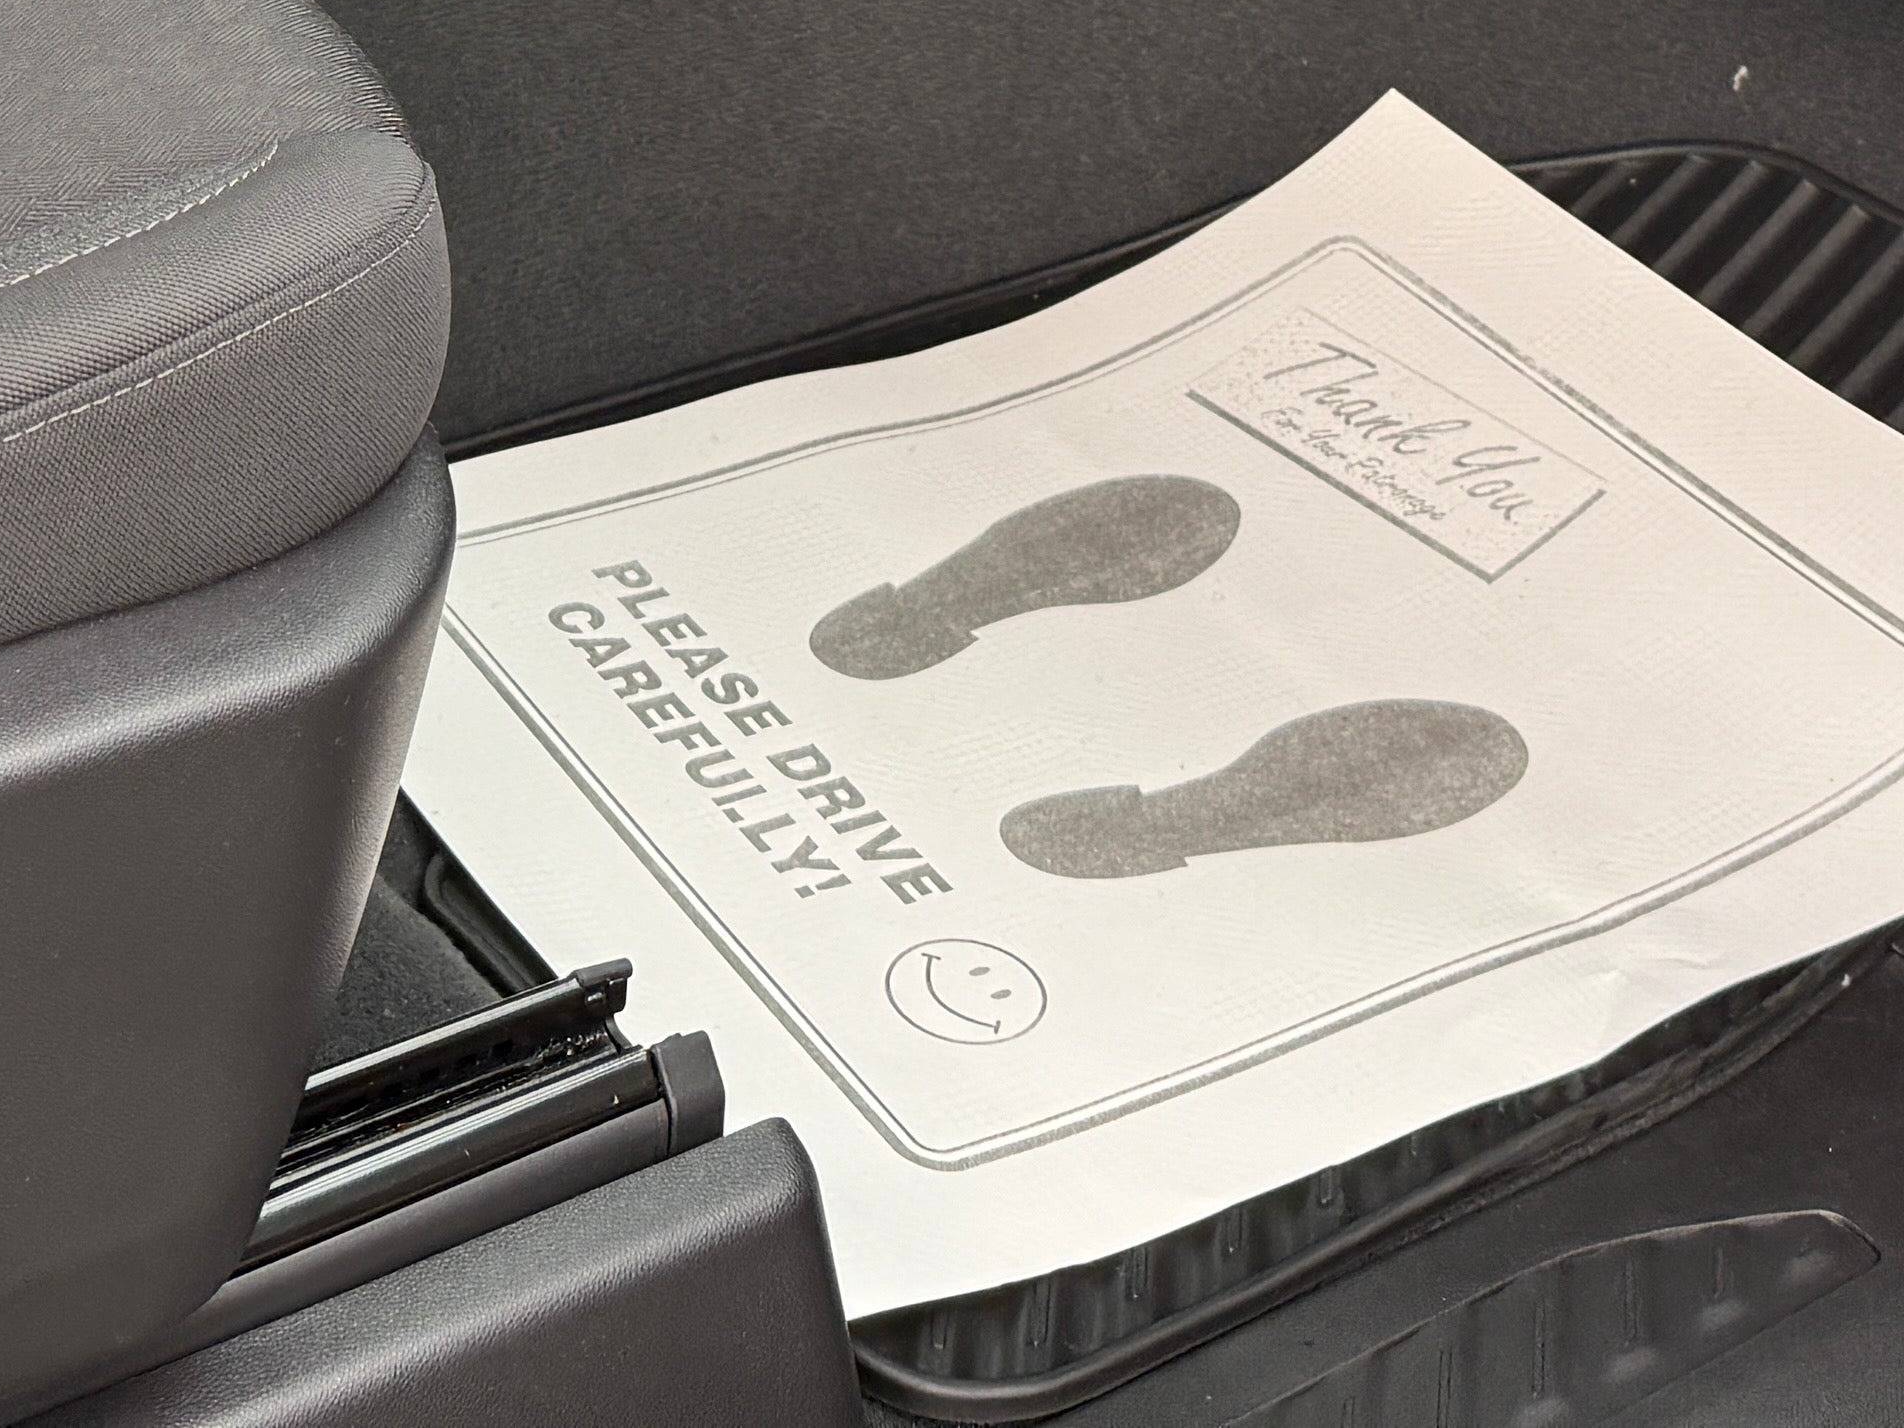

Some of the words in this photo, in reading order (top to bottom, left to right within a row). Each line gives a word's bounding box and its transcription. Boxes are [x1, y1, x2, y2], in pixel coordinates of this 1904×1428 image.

[1263, 342, 1472, 455] Thank
[1435, 446, 1541, 520] You
[1300, 428, 1347, 459] Your
[1344, 456, 1446, 521] Patronage
[547, 601, 853, 900] CAREFULLY!
[591, 559, 794, 738] PLEASE
[765, 742, 955, 905] DRIVE
